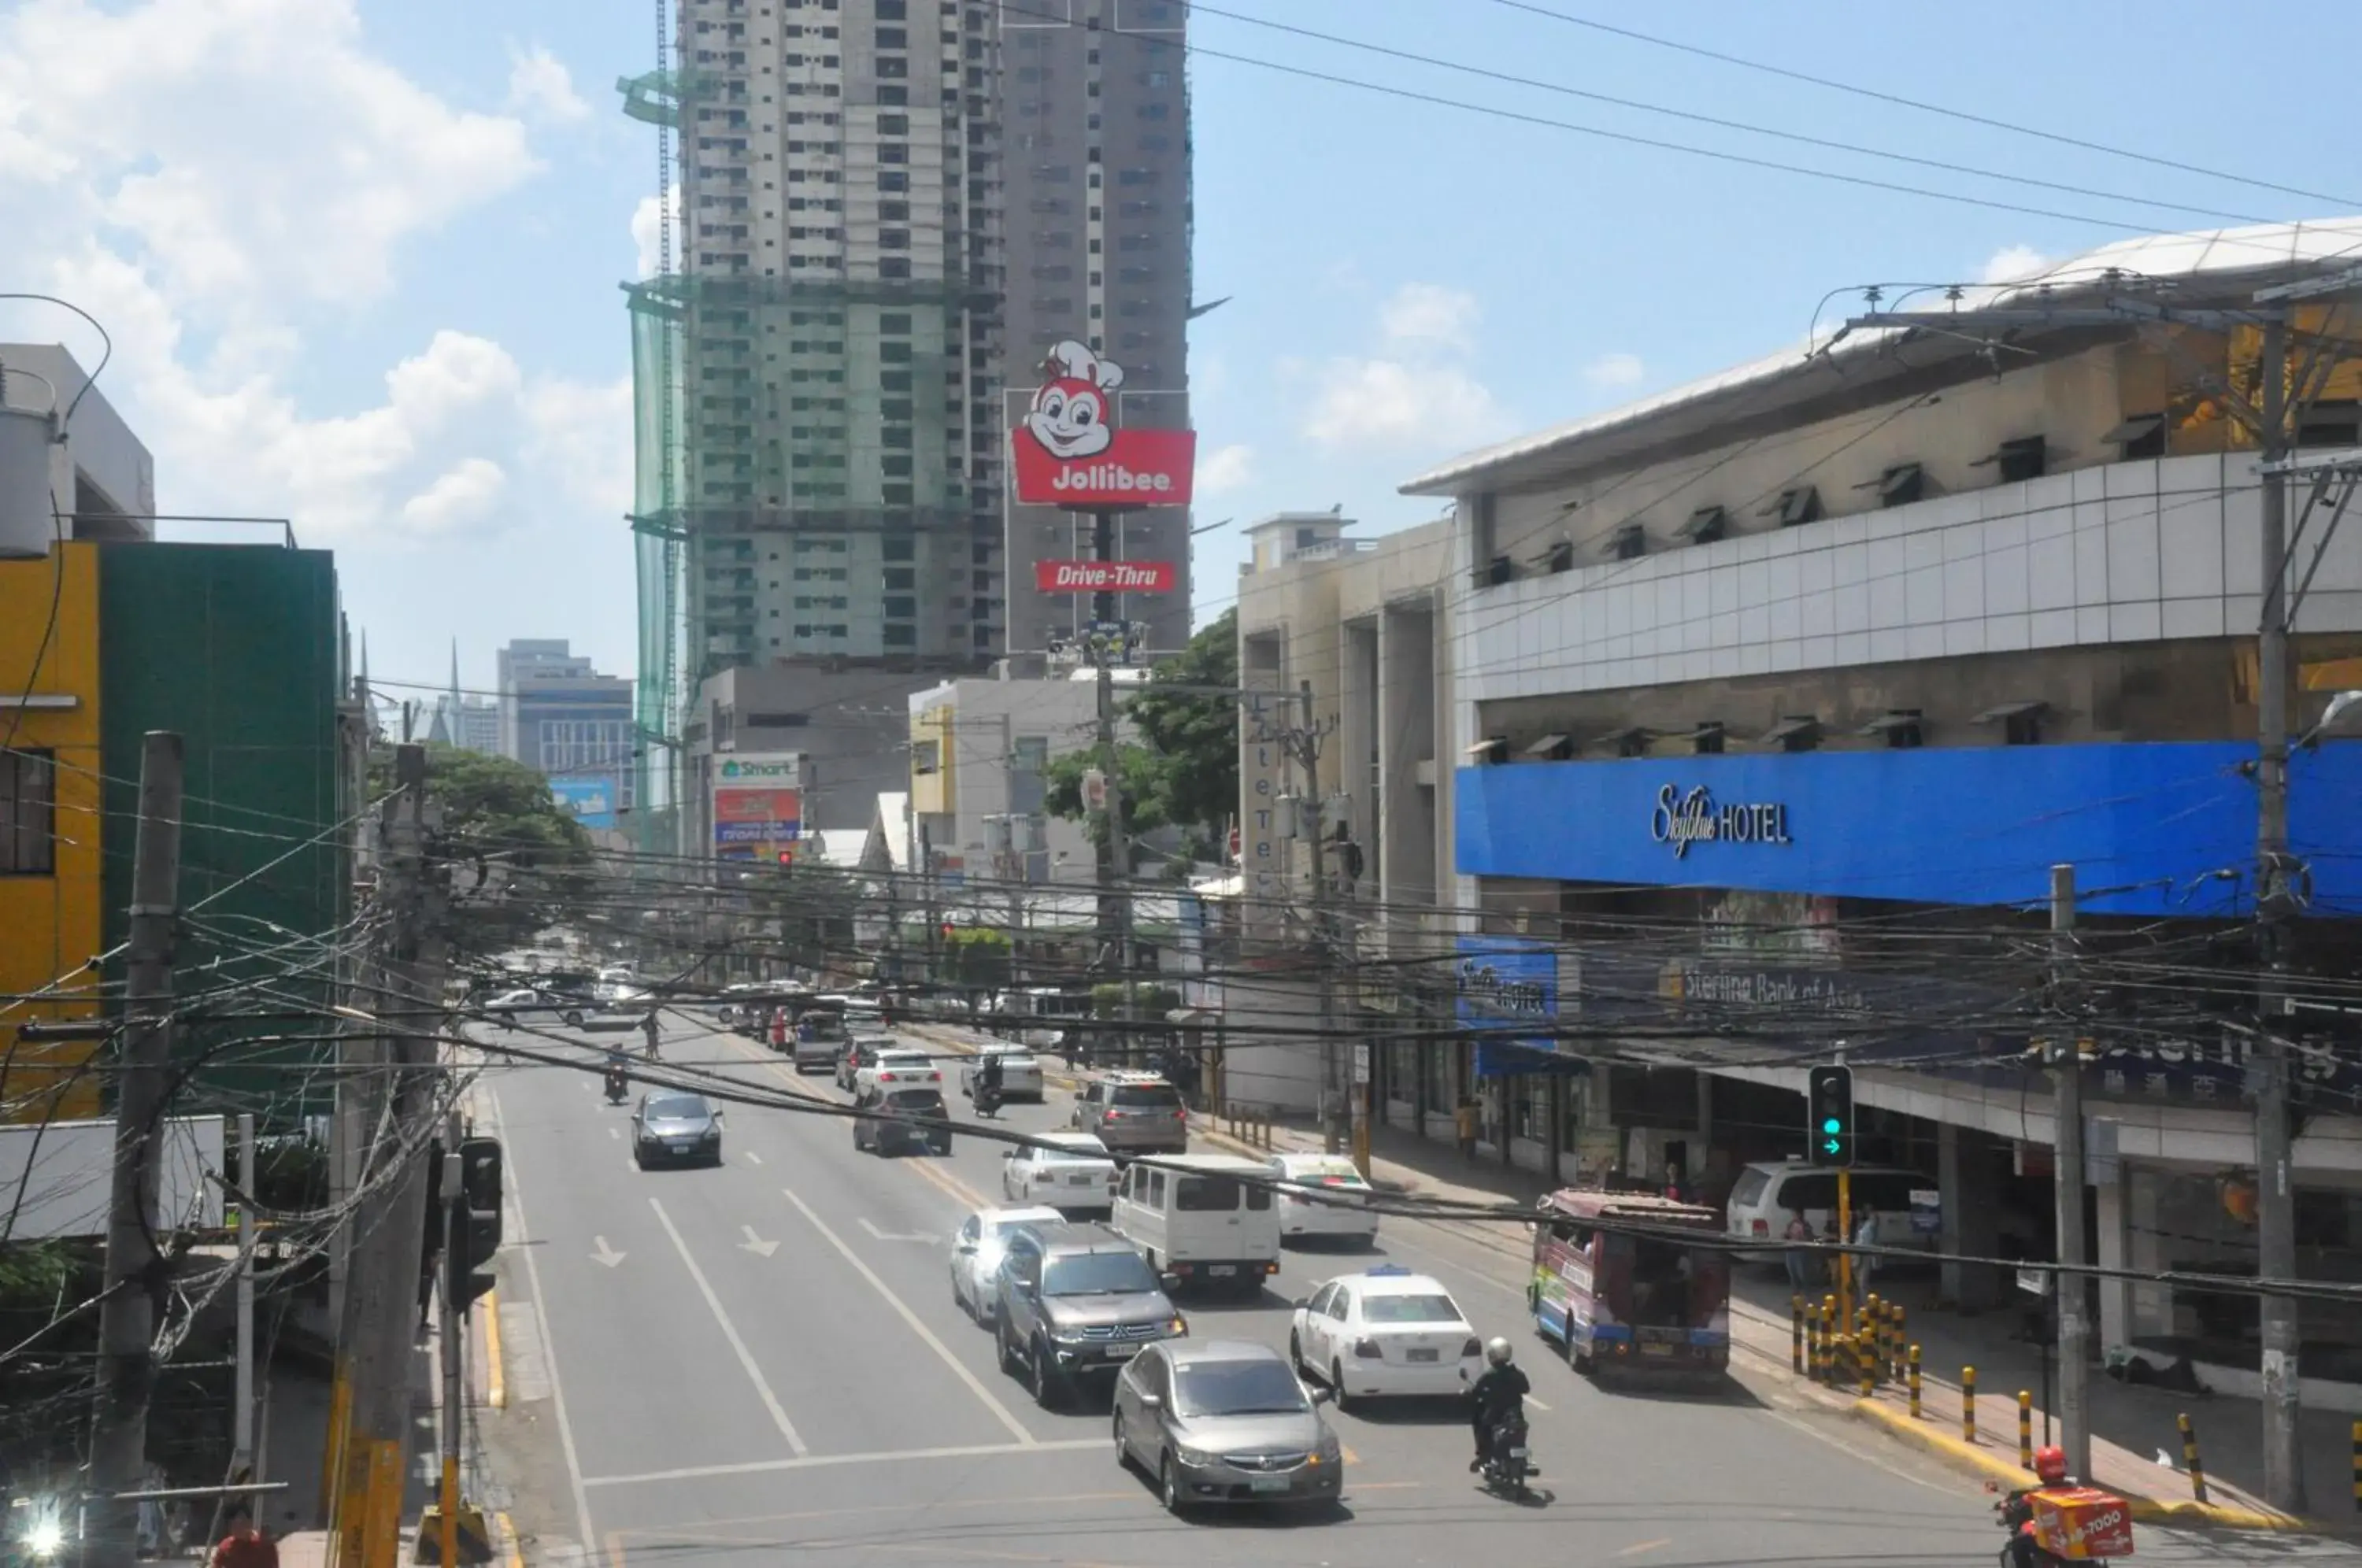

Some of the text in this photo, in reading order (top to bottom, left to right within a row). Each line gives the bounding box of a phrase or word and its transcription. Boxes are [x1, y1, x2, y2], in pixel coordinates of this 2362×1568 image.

[1052, 463, 1171, 490] Jollibee
[1056, 566, 1157, 585] Drive-Thru
[742, 760, 789, 776] Smart
[1652, 784, 1787, 858] Skyblue HOTEL
